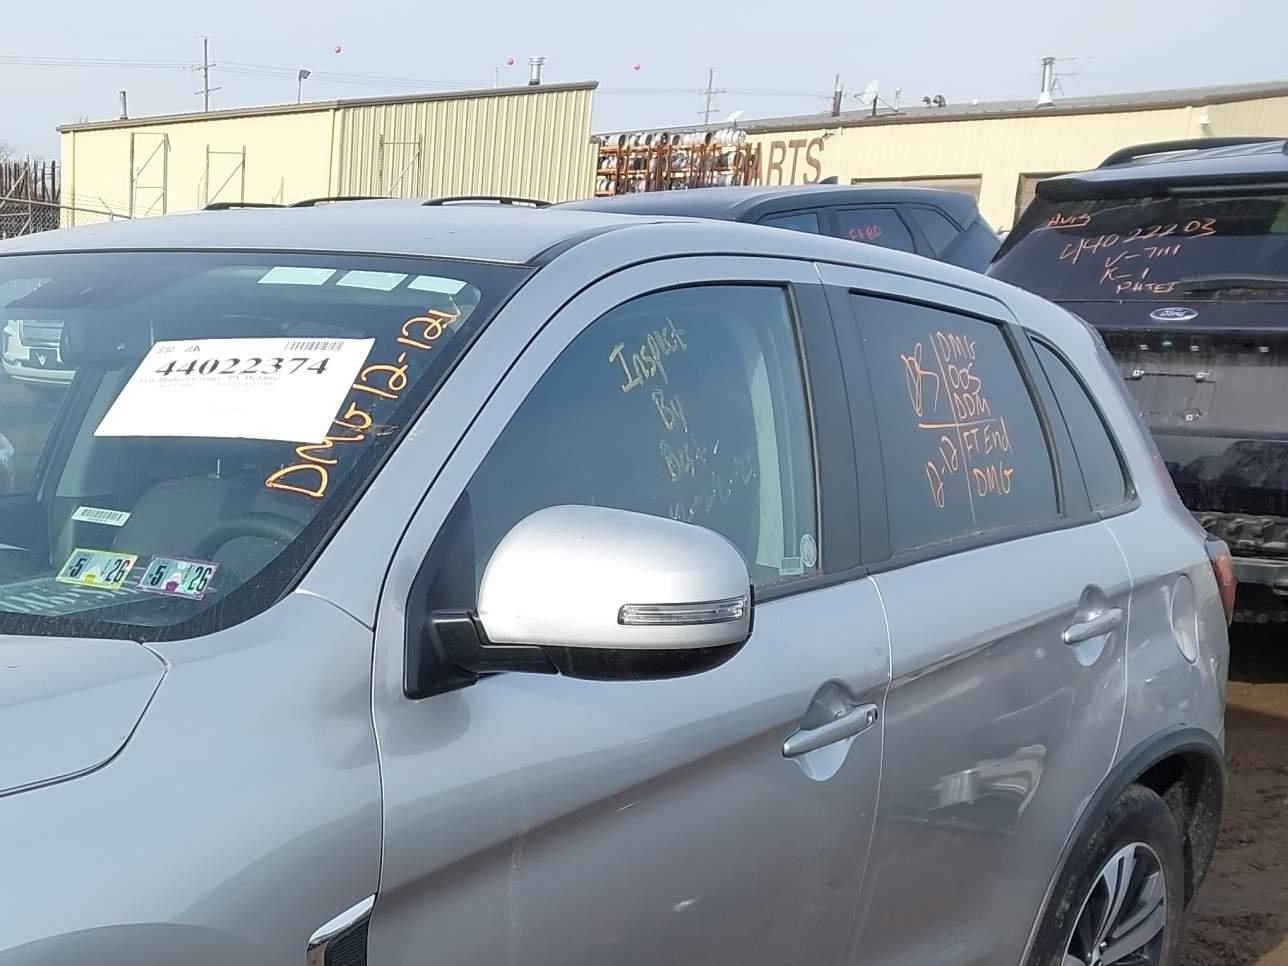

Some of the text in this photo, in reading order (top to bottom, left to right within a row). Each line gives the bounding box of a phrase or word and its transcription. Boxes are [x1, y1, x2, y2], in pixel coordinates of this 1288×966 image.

[155, 357, 330, 376] 44022374
[104, 558, 130, 584] 26
[187, 566, 213, 593] 26
